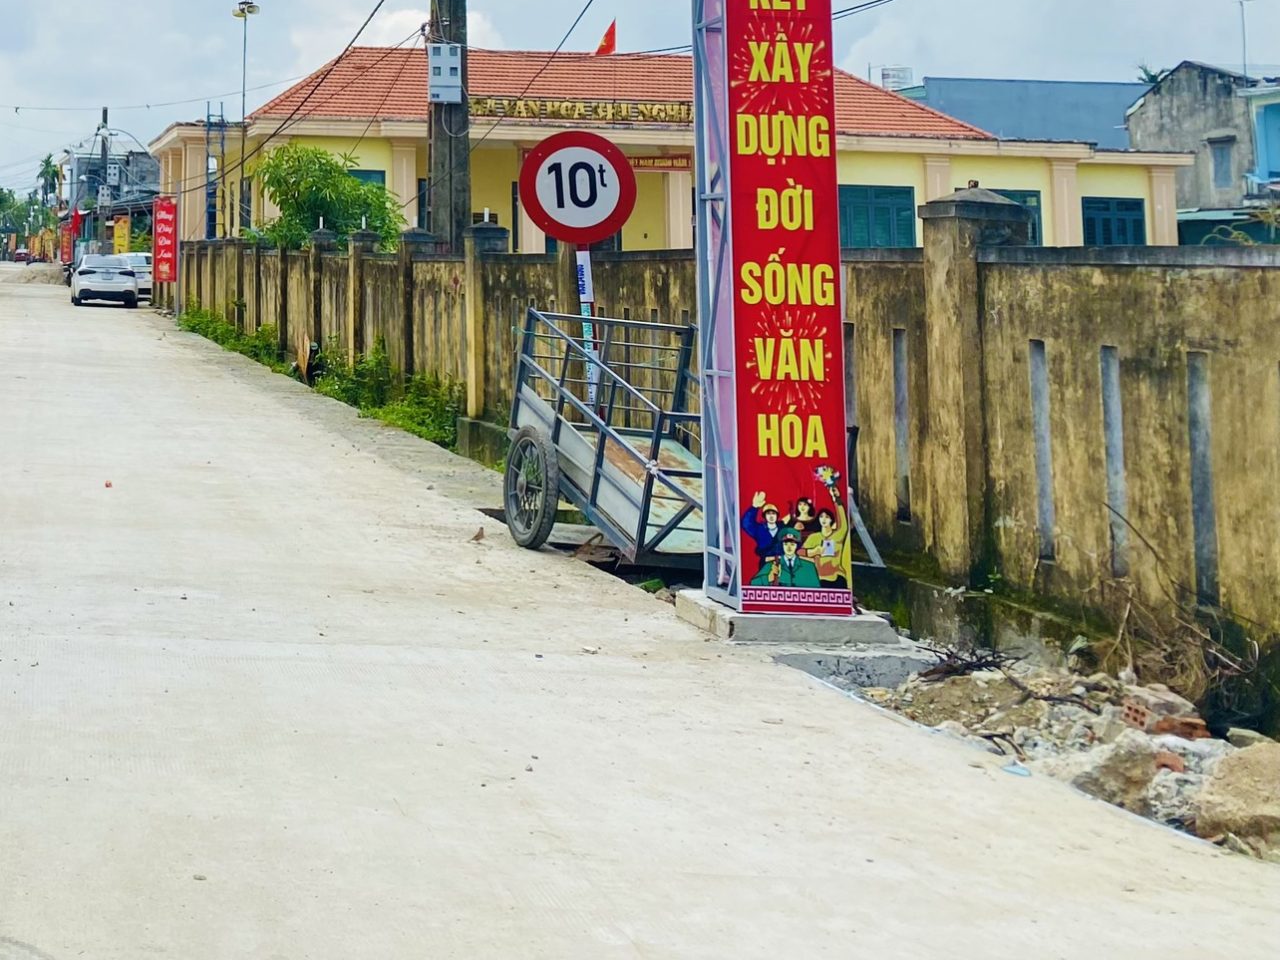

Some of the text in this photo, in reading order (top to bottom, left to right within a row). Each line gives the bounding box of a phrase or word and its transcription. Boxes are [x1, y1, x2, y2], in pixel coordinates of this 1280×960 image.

[748, 33, 814, 84] XÂY
[736, 110, 830, 165] DỰNG
[756, 177, 814, 232] ĐỜI
[740, 247, 835, 307] SỐNG
[754, 328, 825, 382] VĂN
[757, 405, 828, 459] HÓA
